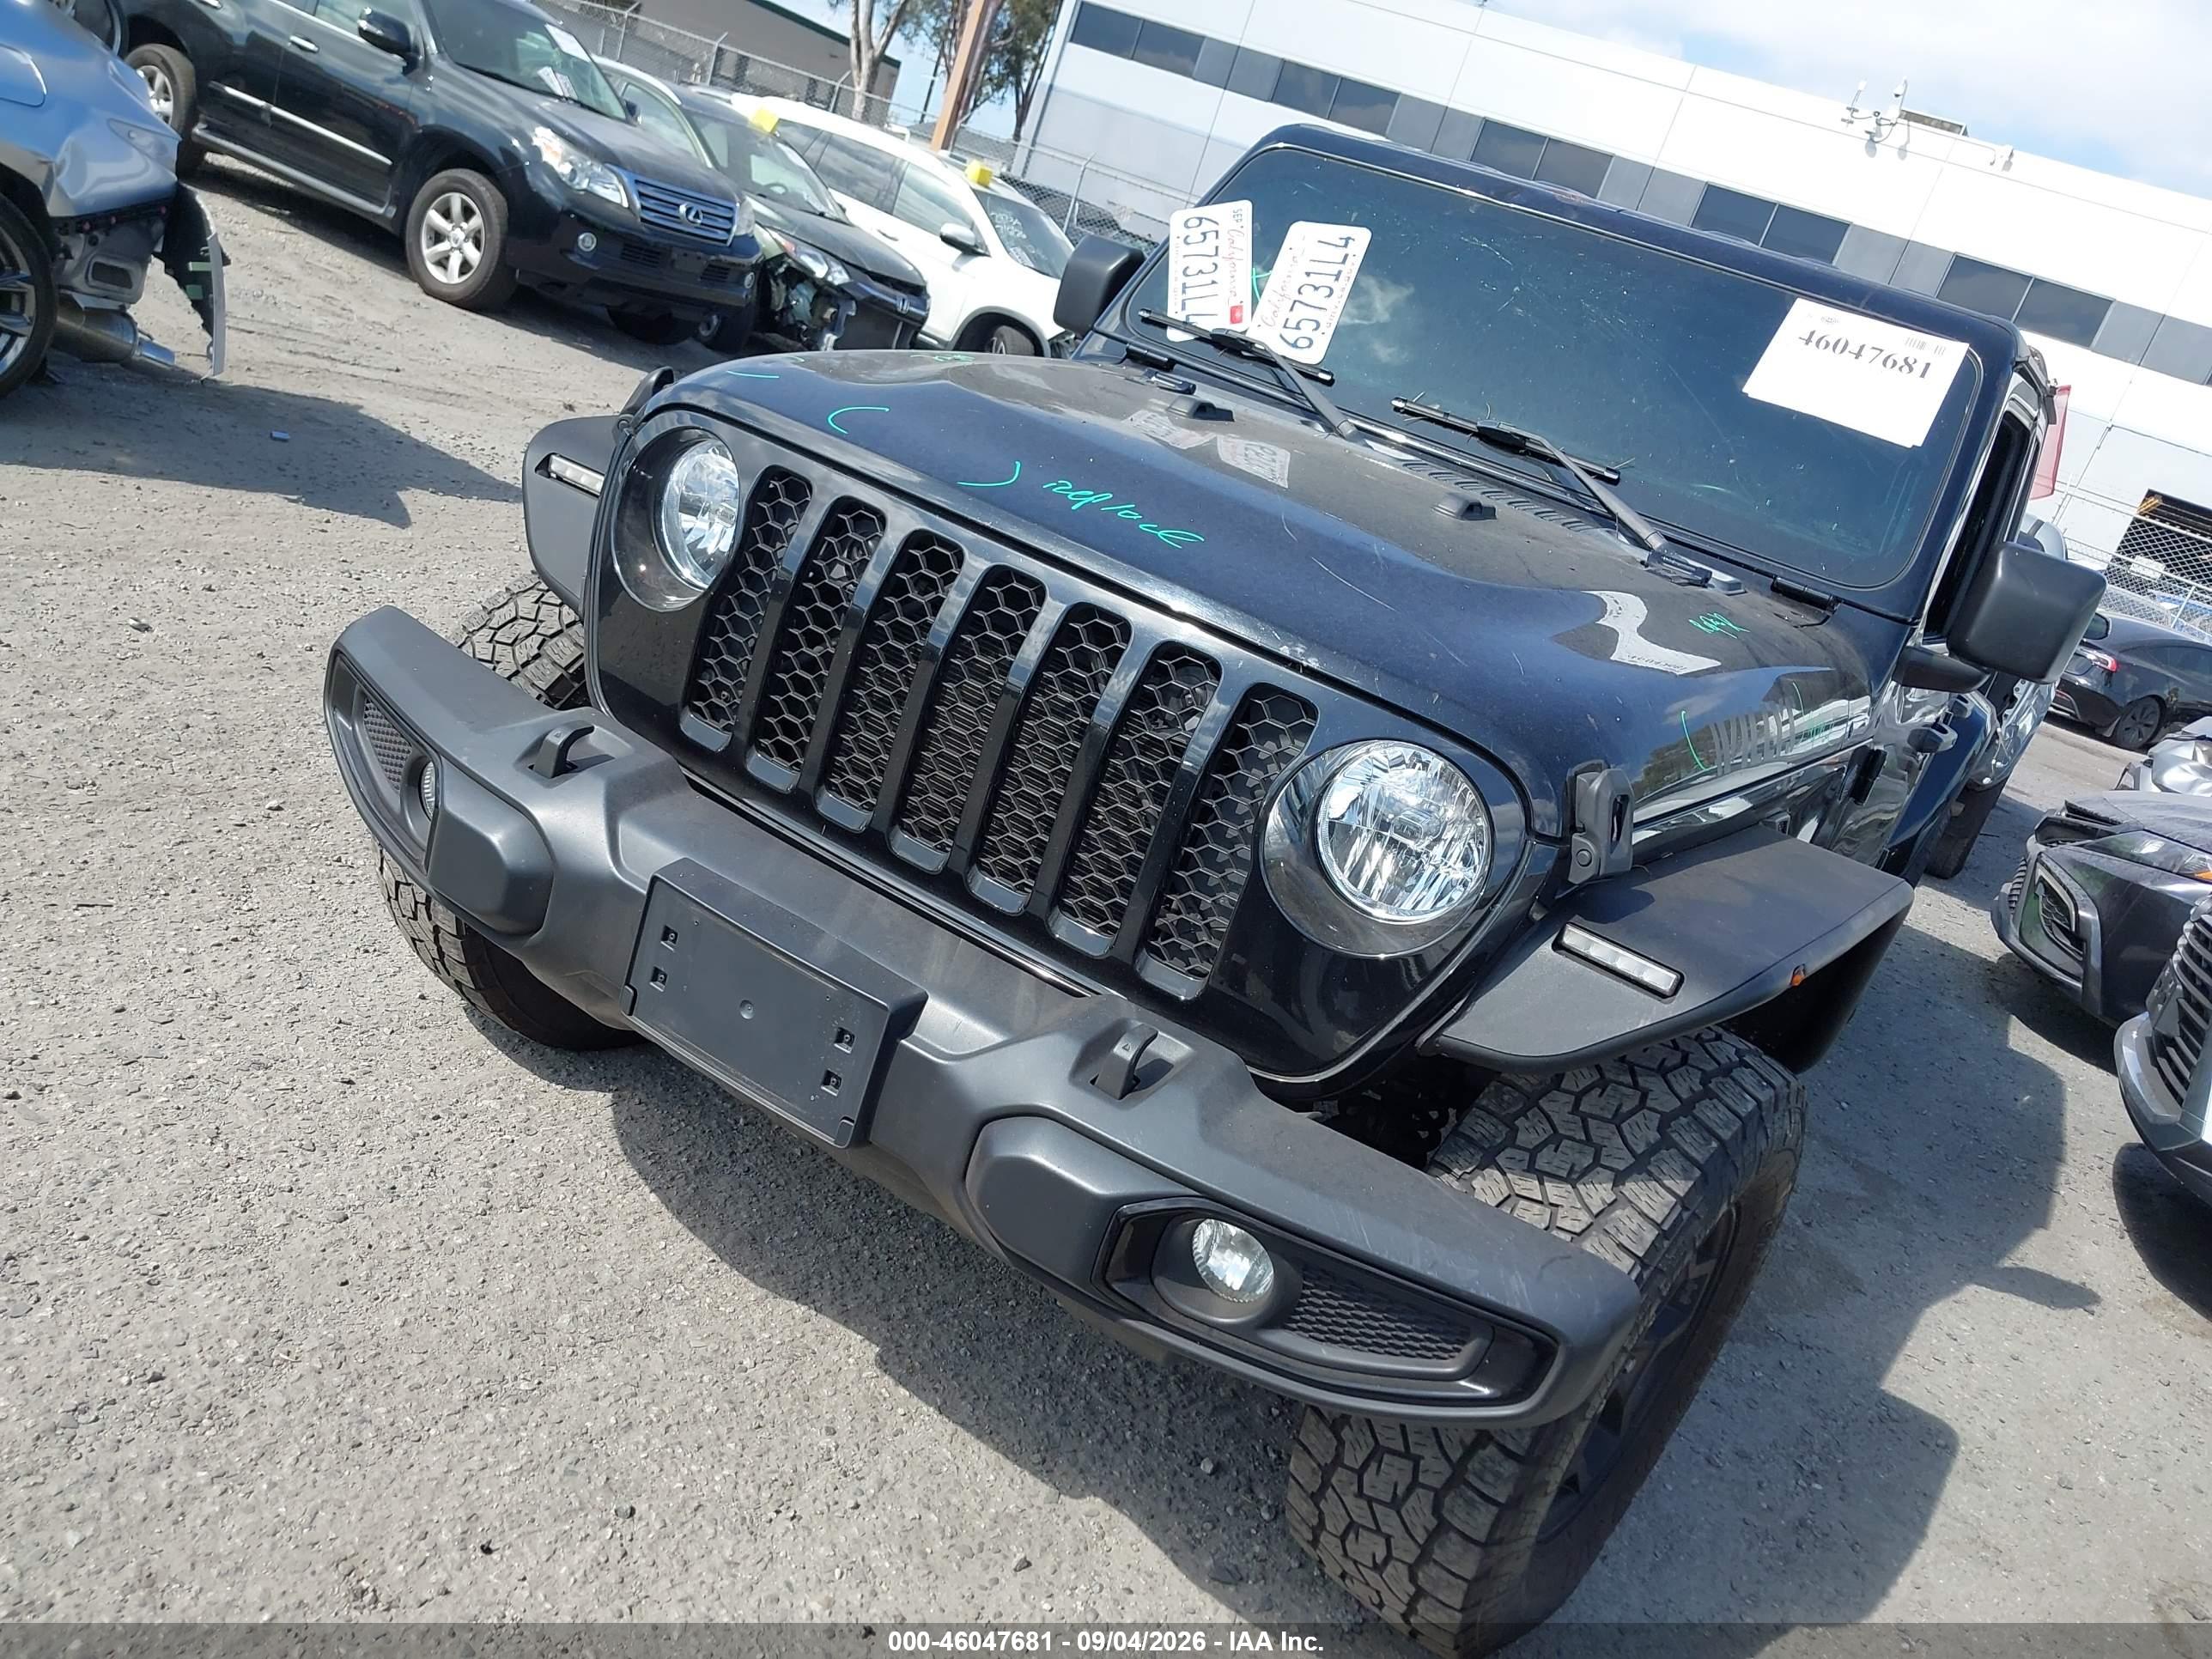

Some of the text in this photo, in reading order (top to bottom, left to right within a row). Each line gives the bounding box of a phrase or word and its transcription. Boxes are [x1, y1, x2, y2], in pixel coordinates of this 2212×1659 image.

[1232, 208, 1243, 223] SEP
[1223, 228, 1245, 301] California
[1279, 236, 1356, 349] 65731L4
[1798, 330, 1931, 379] 46047681
